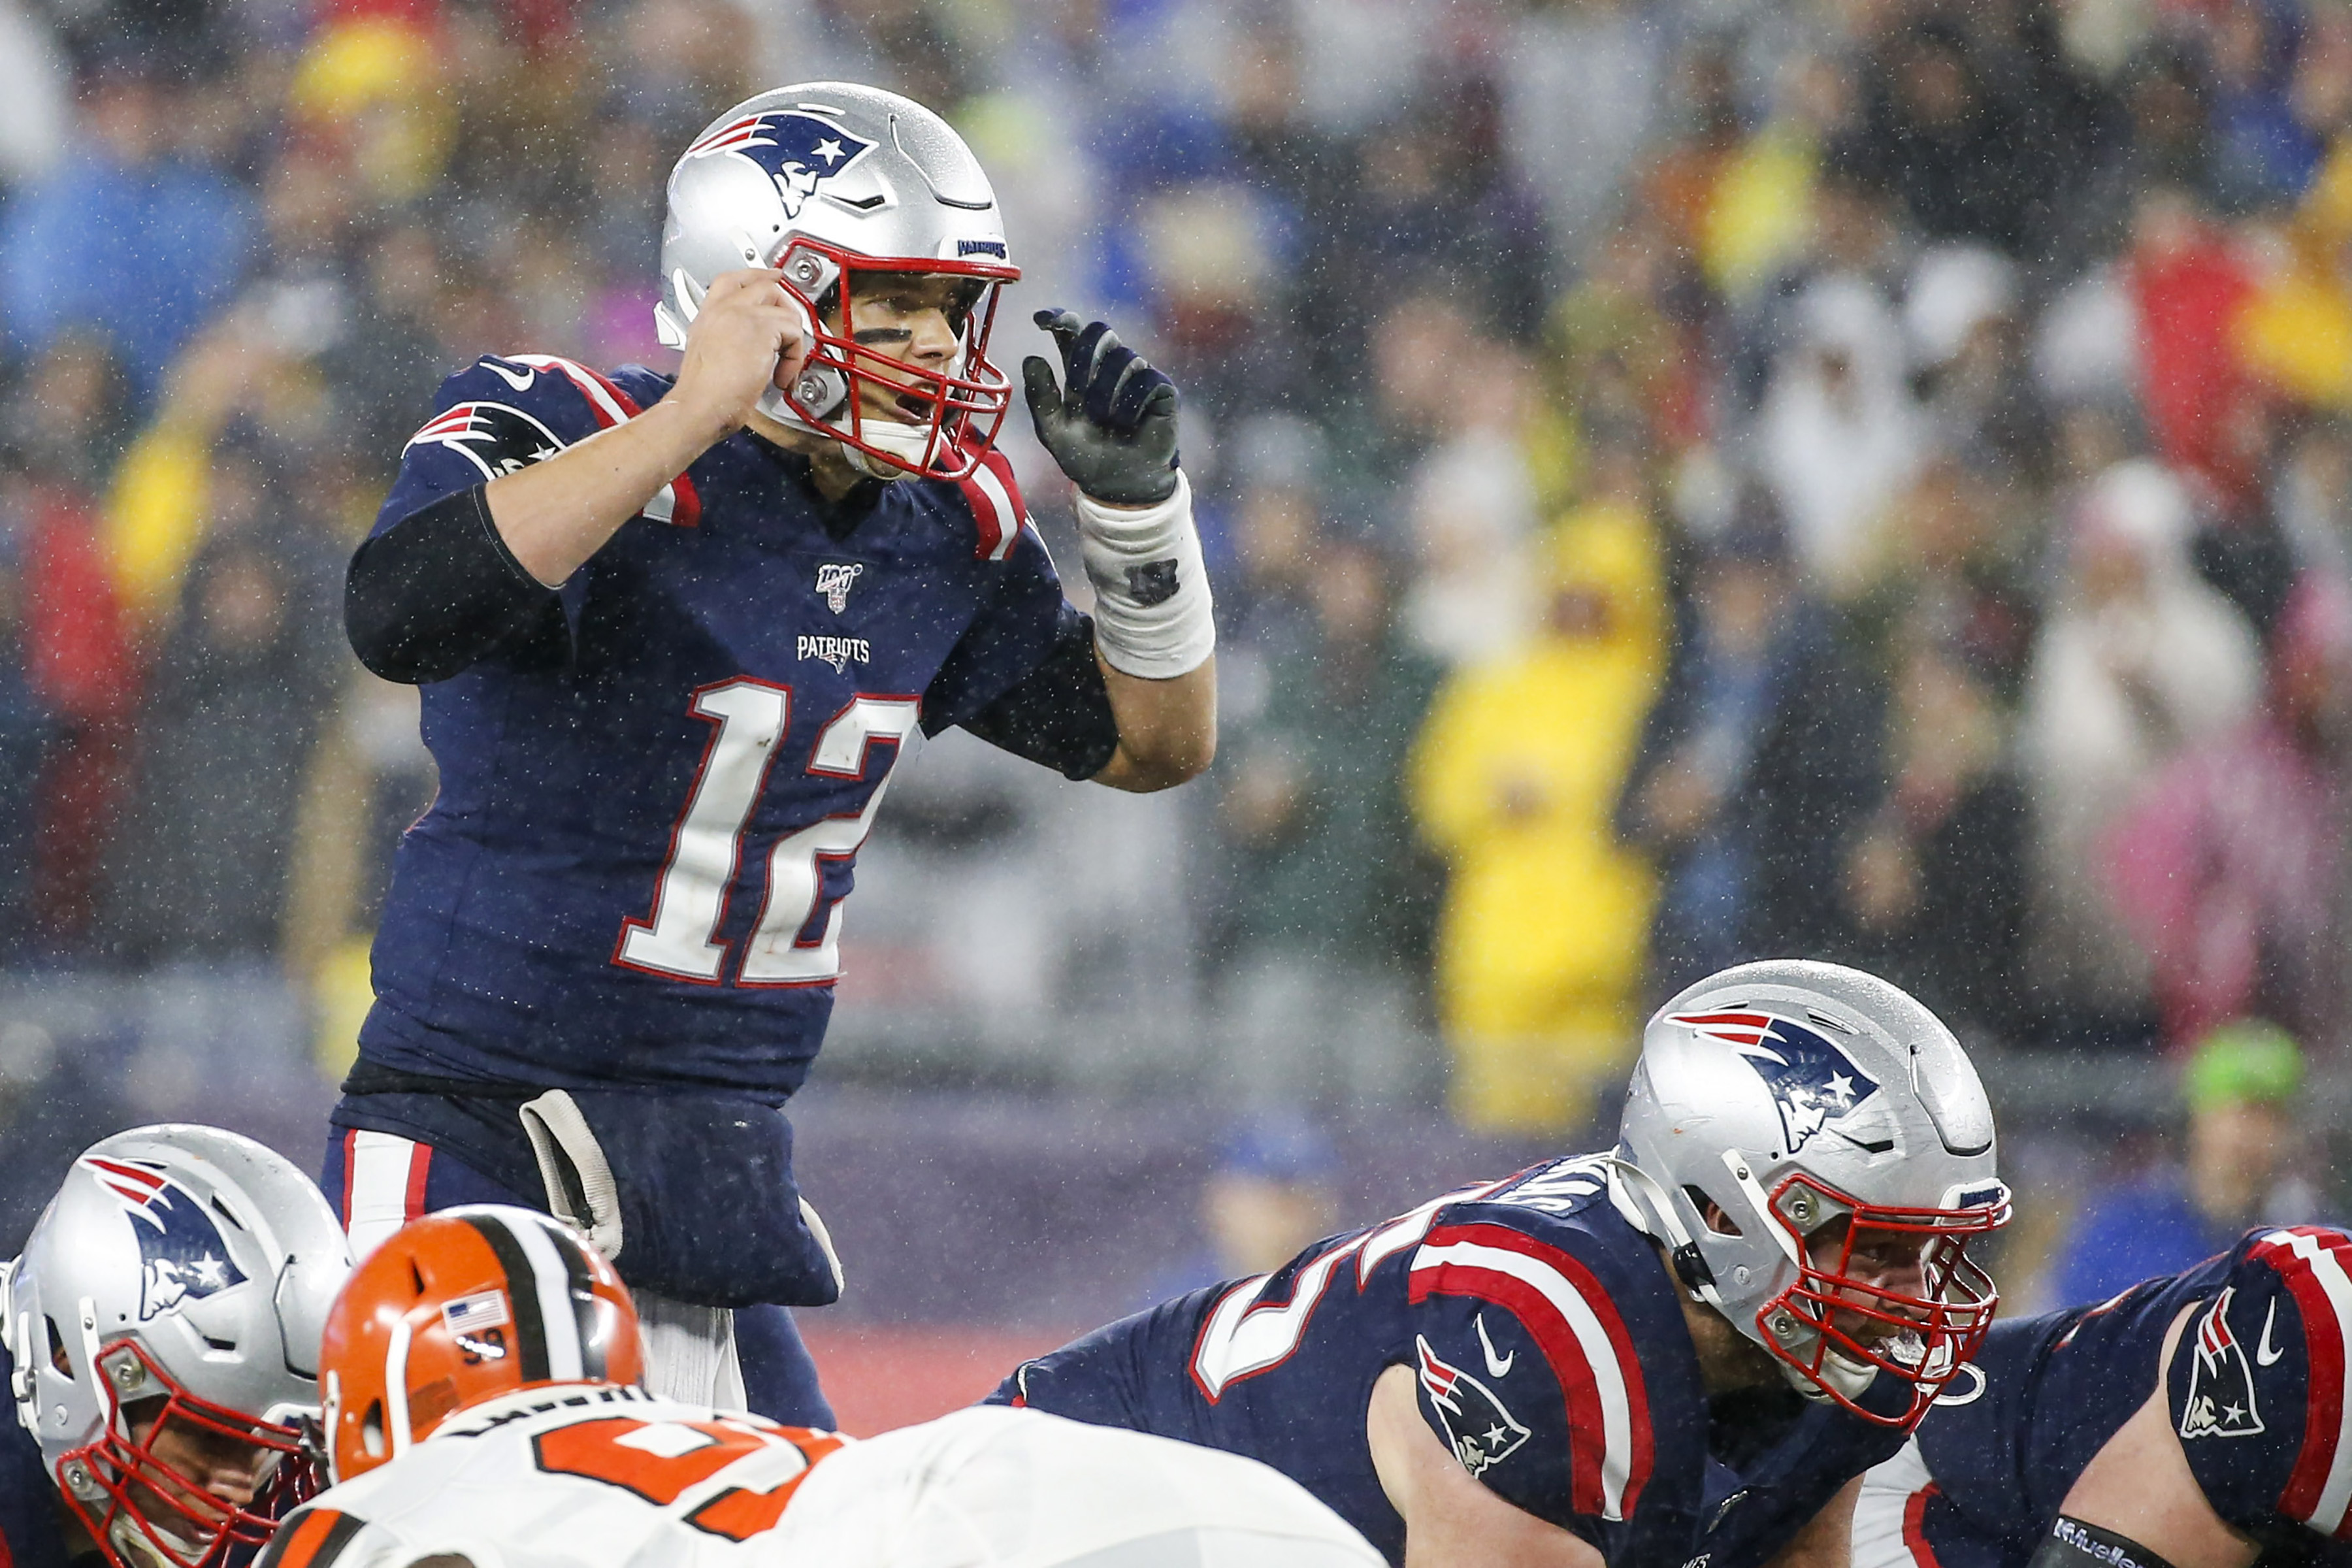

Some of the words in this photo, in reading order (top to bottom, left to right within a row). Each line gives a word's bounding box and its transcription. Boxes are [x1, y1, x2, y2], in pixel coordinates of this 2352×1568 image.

[796, 635, 870, 664] PATRIOTS
[610, 674, 922, 988] 12
[2066, 1522, 2146, 1568] Muelle
